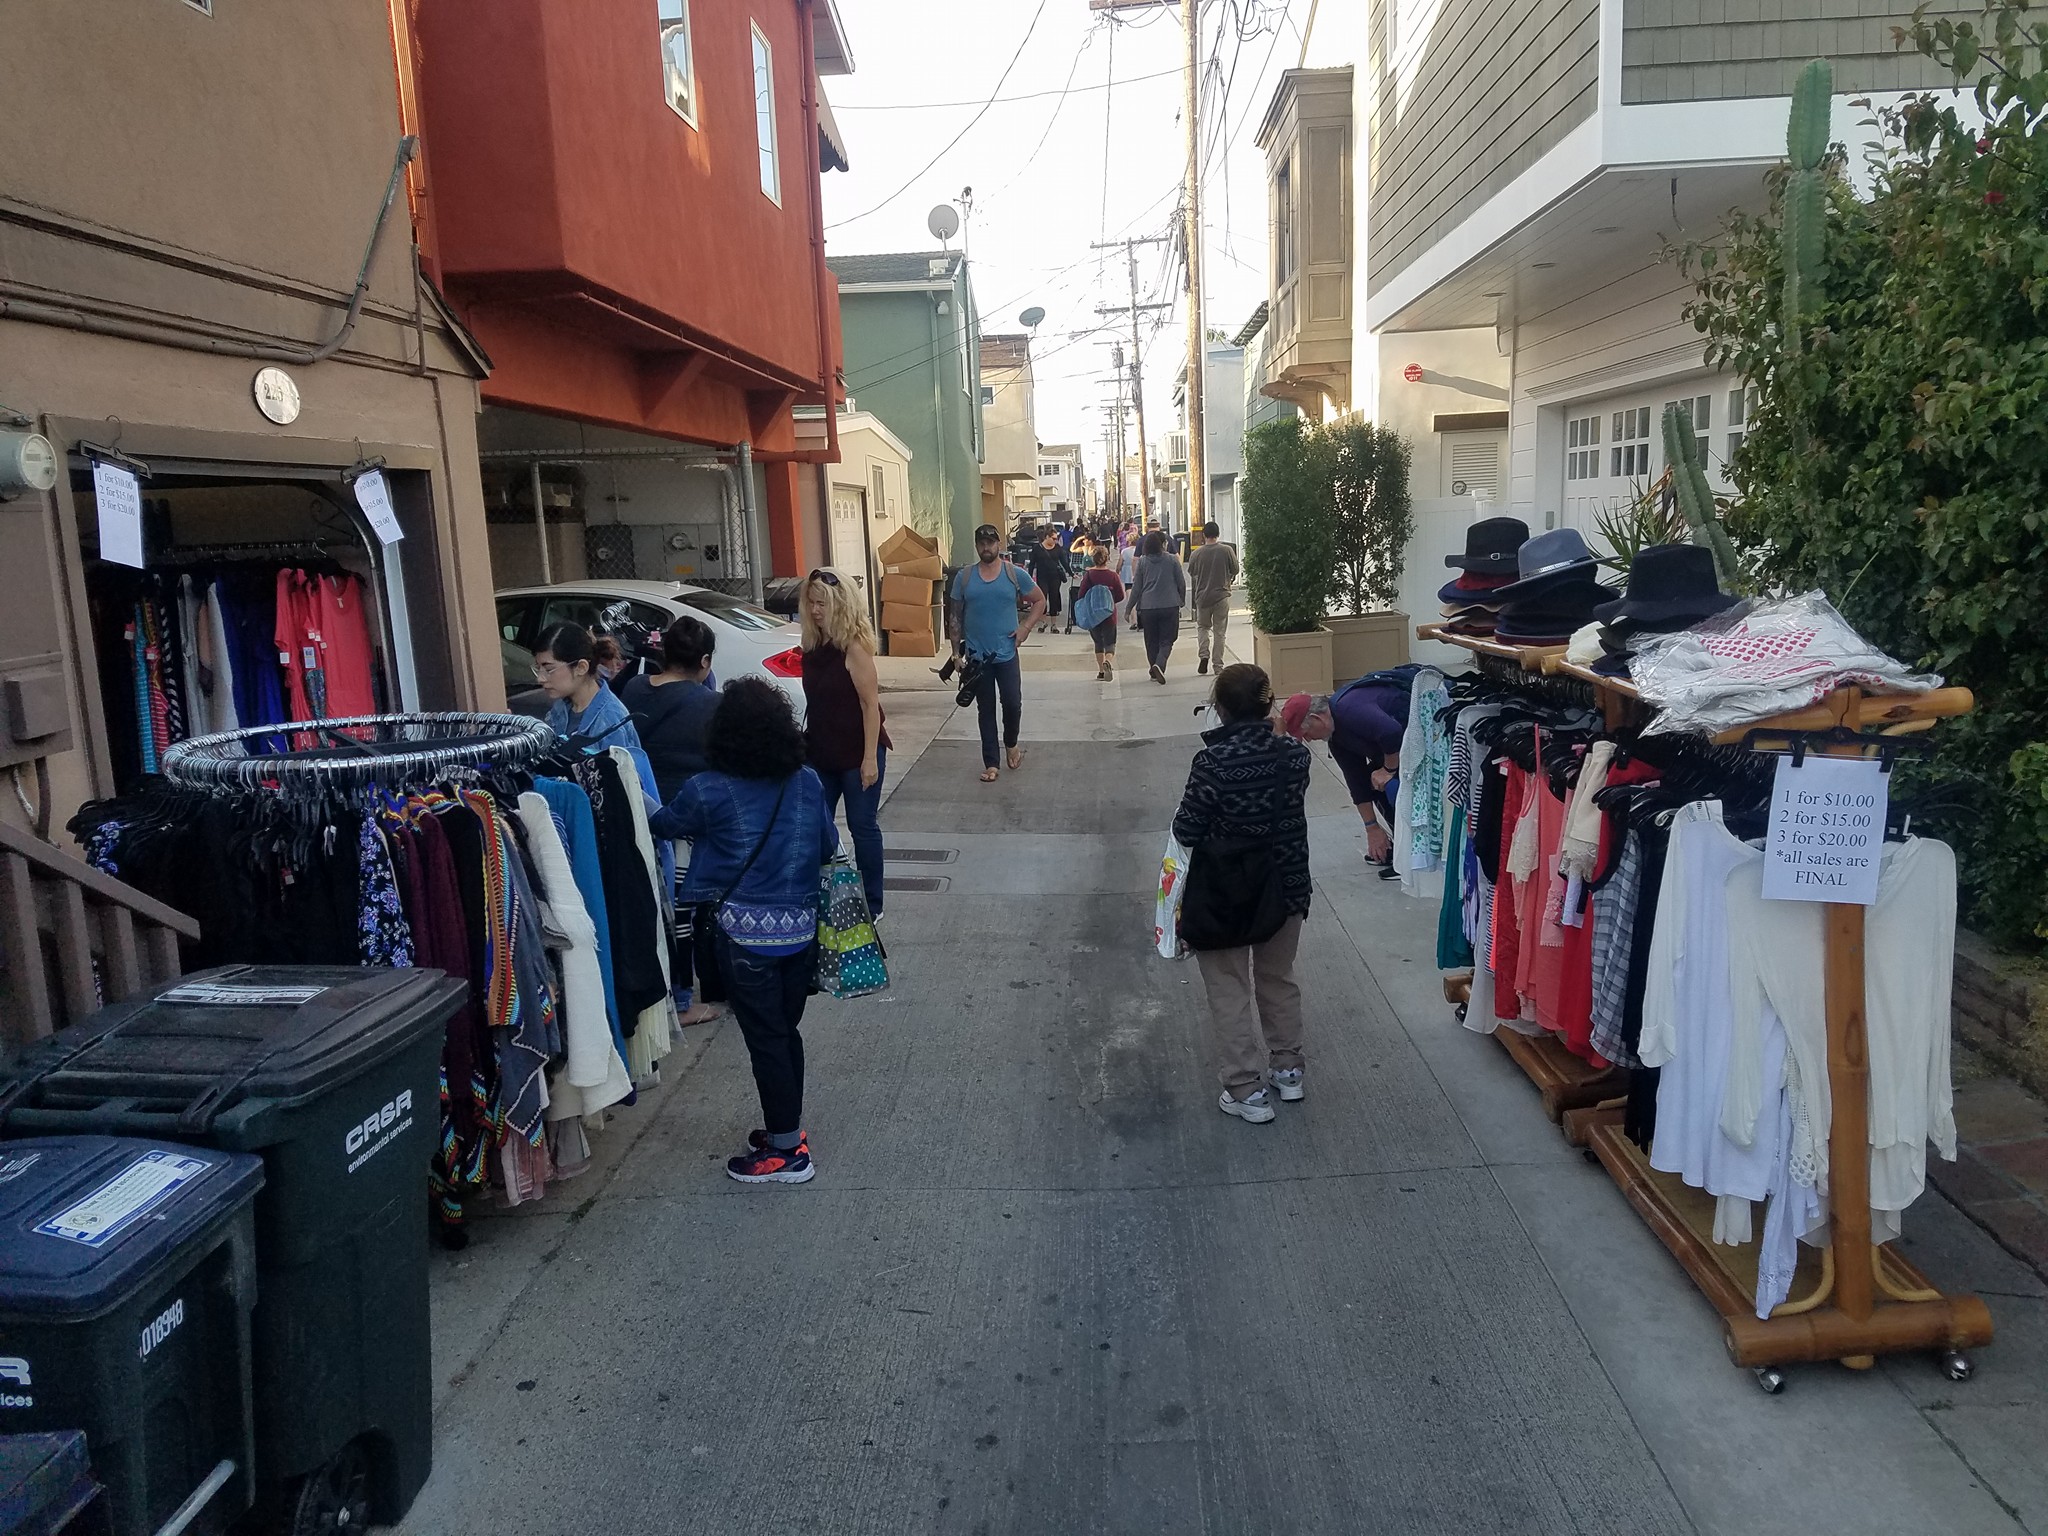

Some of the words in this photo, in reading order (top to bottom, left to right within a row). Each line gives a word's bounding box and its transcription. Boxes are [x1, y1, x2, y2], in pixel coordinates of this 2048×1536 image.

[98, 471, 101, 480] 1
[104, 473, 114, 483] for
[114, 476, 133, 489] $10.00
[100, 485, 104, 494] 2
[106, 487, 115, 497] for
[115, 490, 135, 502] $15.00
[101, 498, 106, 508] 3
[107, 500, 116, 510] for
[117, 503, 135, 516] $20.00
[1785, 790, 1790, 803] 1
[1797, 790, 1820, 805] for
[1823, 792, 1875, 808] $10.00
[1779, 809, 1789, 823] 2
[1794, 810, 1817, 825] for
[1820, 812, 1871, 828] $15.00
[1777, 829, 1786, 843] 3
[1792, 830, 1814, 845] for
[1817, 832, 1867, 847] $20.00
[1806, 852, 1842, 867] sales
[1846, 856, 1869, 868] are
[1794, 870, 1848, 886] FINAL
[345, 1088, 412, 1155] CR&R
[347, 1132, 390, 1174] environmental
[389, 1116, 413, 1140] services
[139, 1298, 183, 1358] 018948
[0, 1392, 33, 1407] ices
